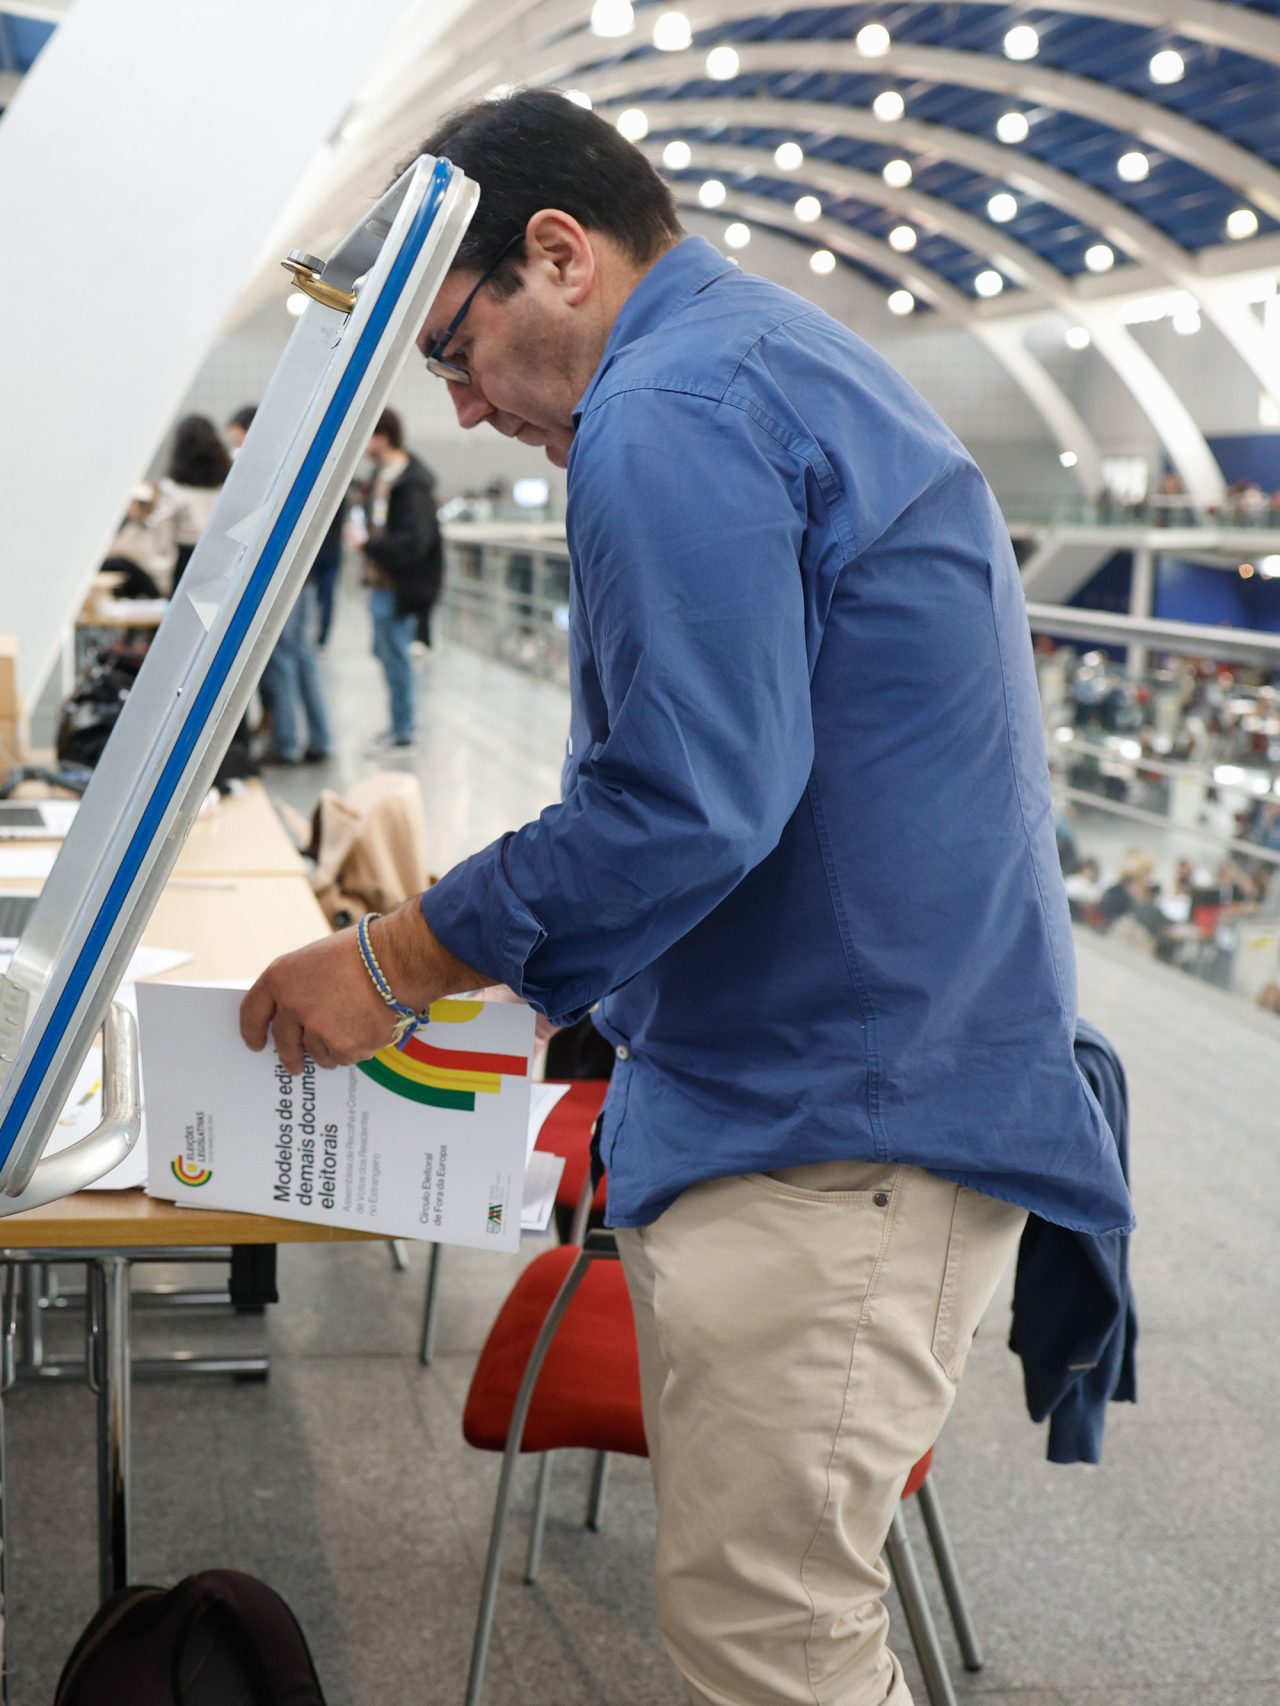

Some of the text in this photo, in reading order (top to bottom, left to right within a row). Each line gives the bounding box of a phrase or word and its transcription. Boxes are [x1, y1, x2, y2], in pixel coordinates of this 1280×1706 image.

[275, 1099, 293, 1120] de
[347, 1067, 358, 1107] Contagem
[185, 1125, 195, 1161] ELEIÇÕES
[196, 1111, 206, 1162] LEGISLATIVAS
[296, 1048, 316, 1206] demais documen
[346, 1116, 356, 1150] Recolha
[273, 1124, 293, 1202] Modelos
[318, 1124, 338, 1209] eleitorais
[346, 1151, 354, 1161] de
[356, 1112, 368, 1215] de Votos dos Residentes
[422, 1153, 433, 1190] Eleitoral
[342, 1163, 354, 1212] Assembleia
[368, 1153, 380, 1216] no Estrangeiro
[433, 1145, 448, 1226] de Fora da Europa
